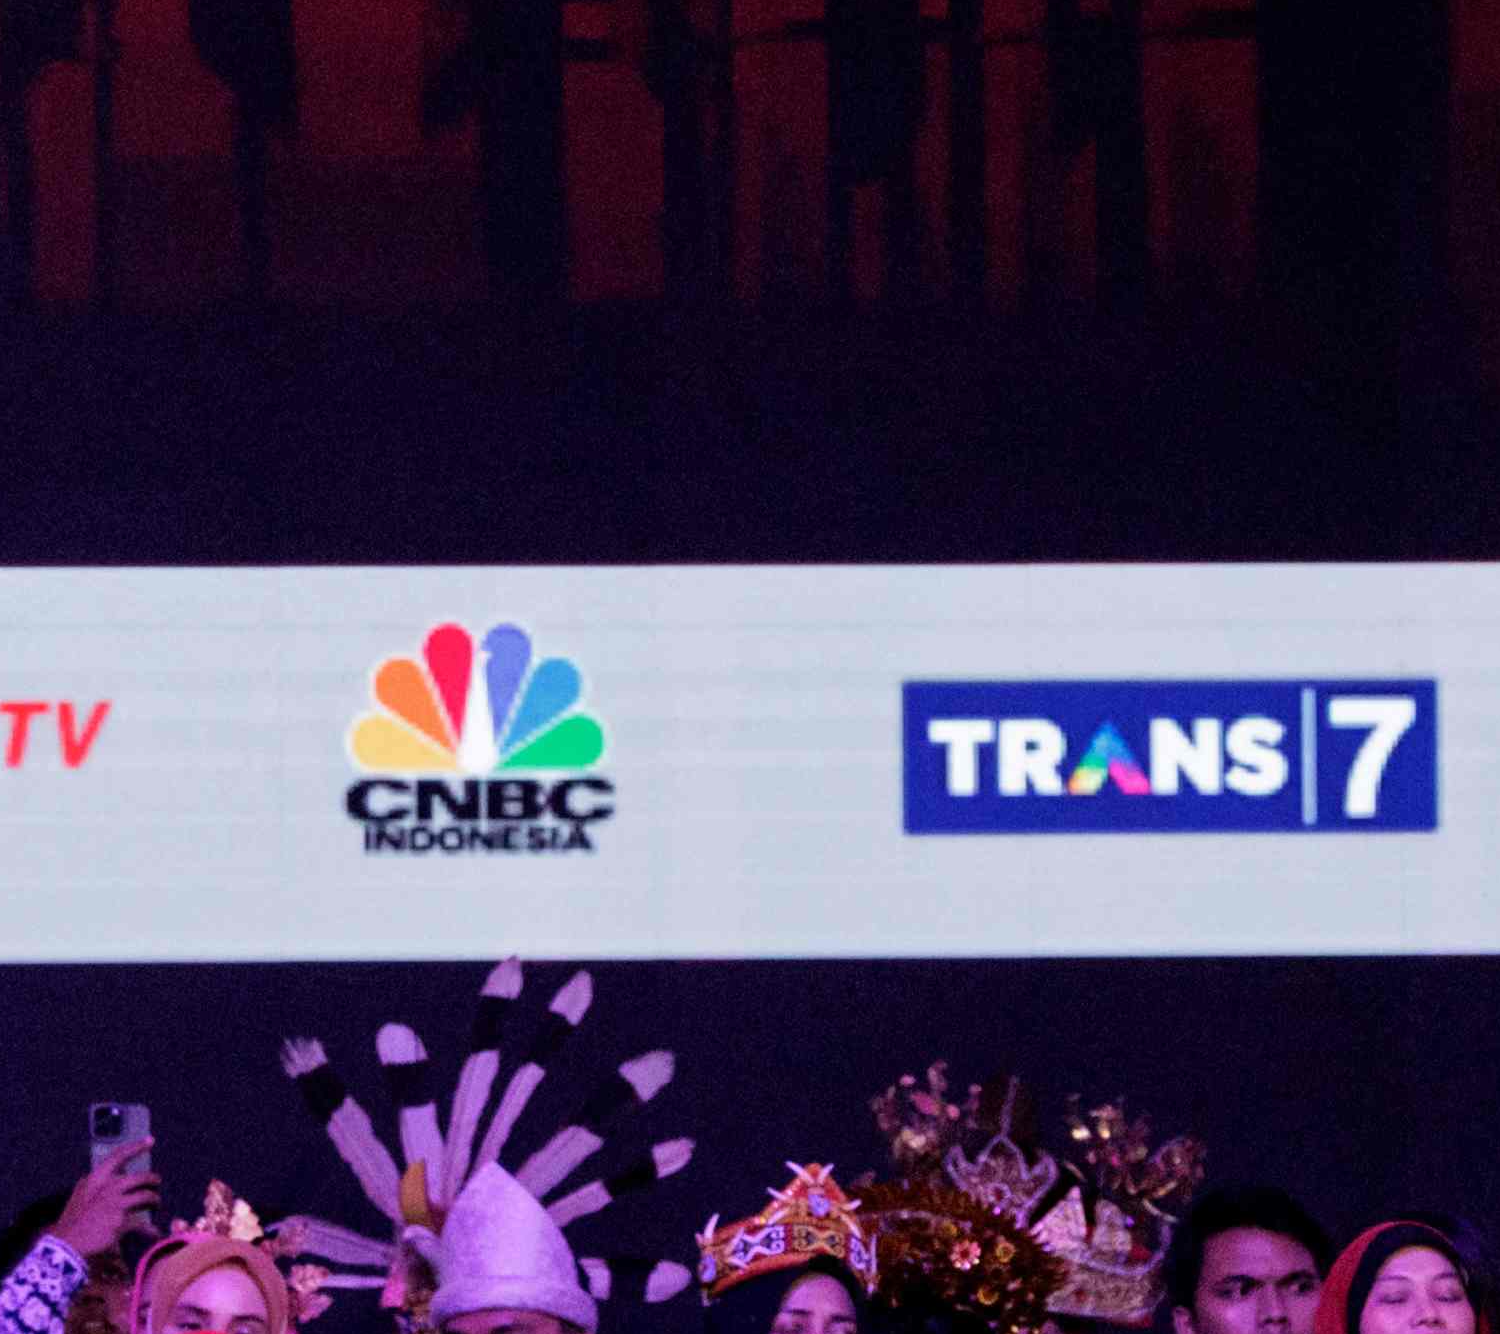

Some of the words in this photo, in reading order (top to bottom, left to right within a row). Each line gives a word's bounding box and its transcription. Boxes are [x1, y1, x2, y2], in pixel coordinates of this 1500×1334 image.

[927, 715, 1290, 798] TRANS
[1326, 695, 1418, 820] 7
[345, 776, 614, 822] CNBC
[363, 822, 594, 853] INDONESIA
